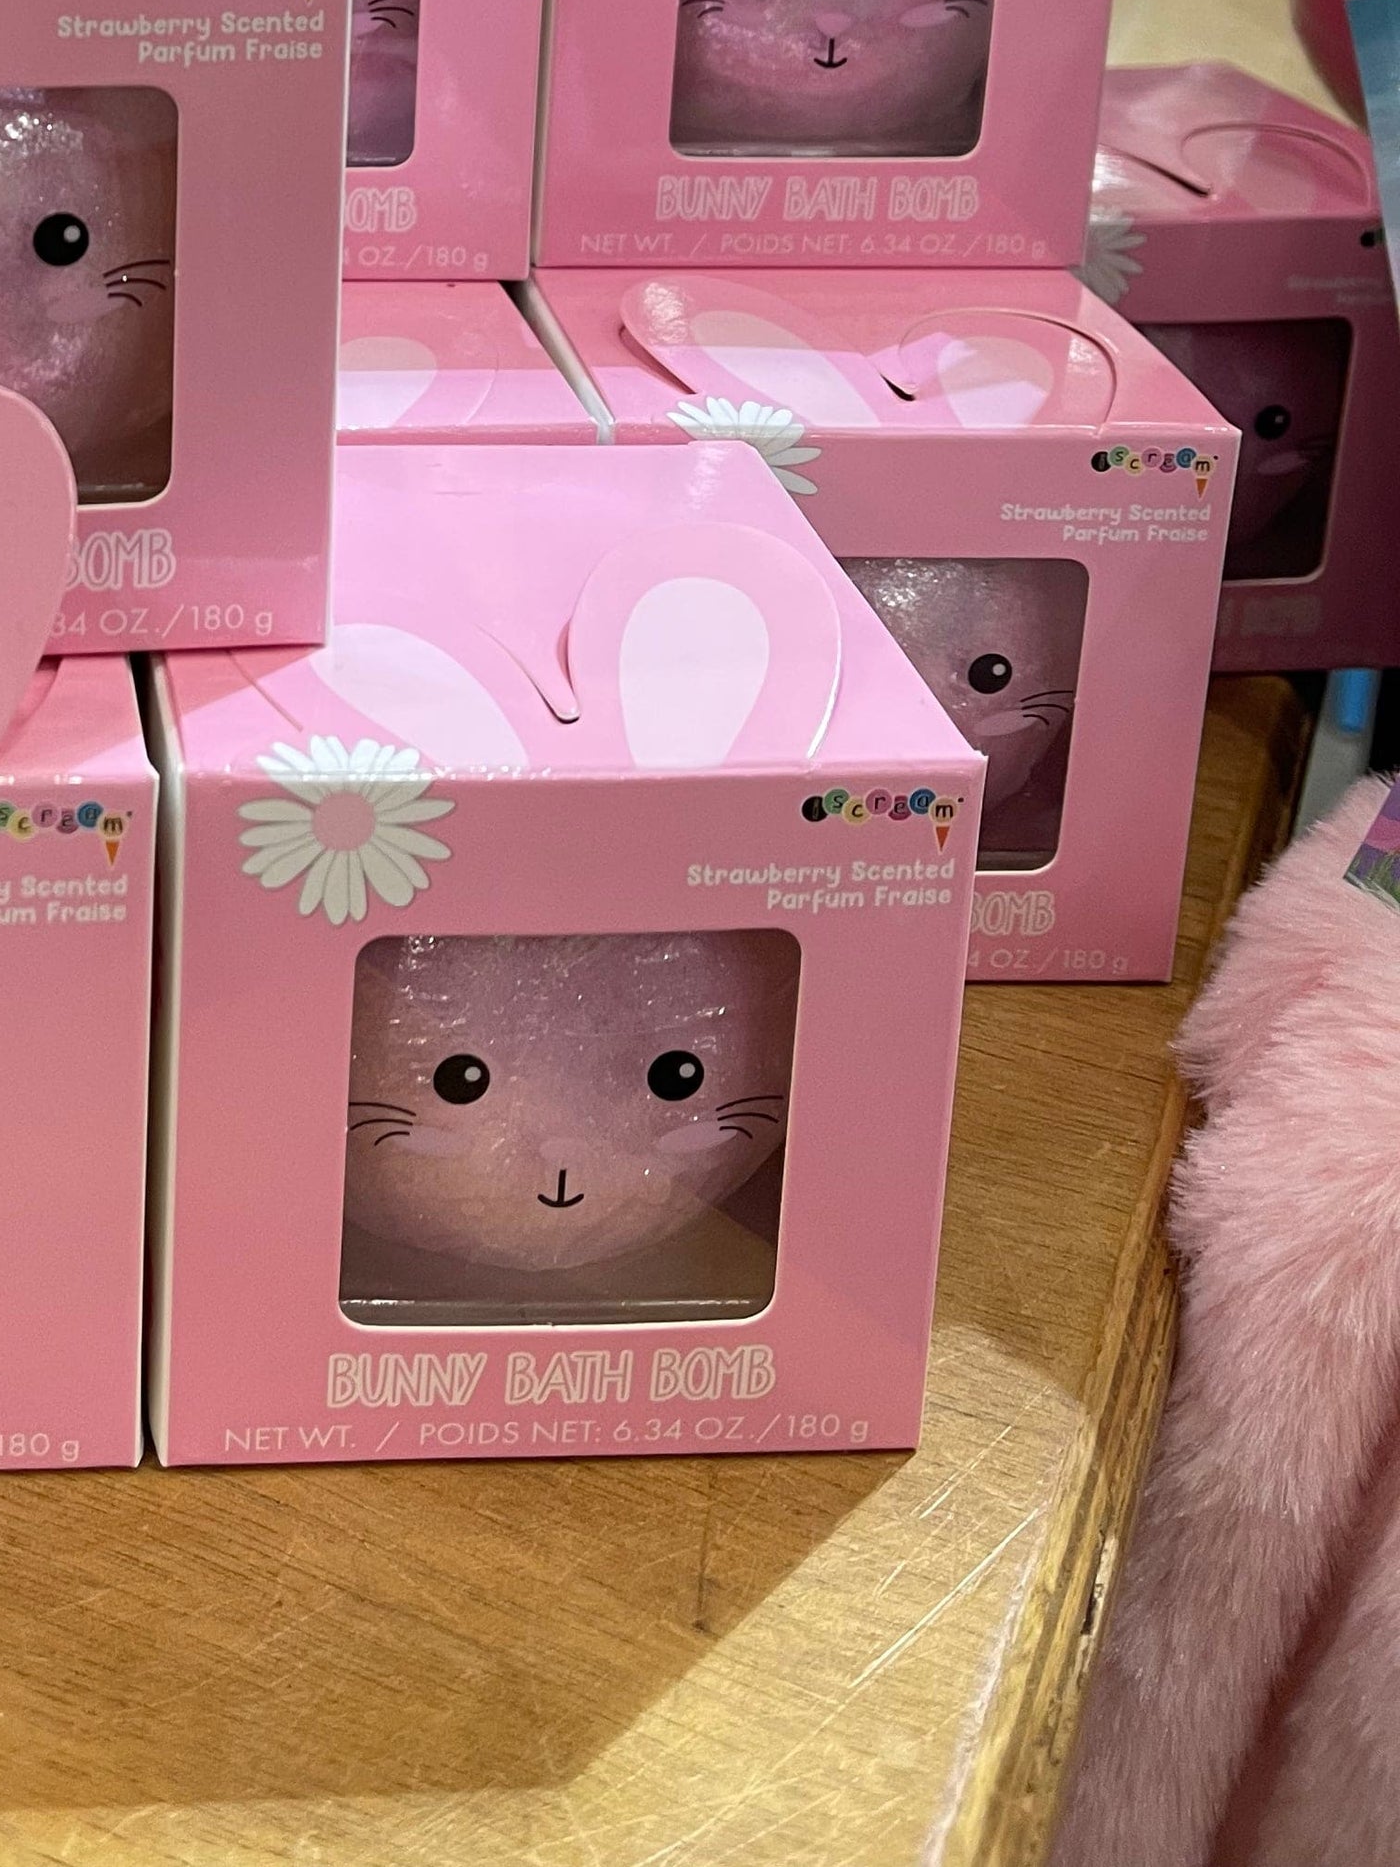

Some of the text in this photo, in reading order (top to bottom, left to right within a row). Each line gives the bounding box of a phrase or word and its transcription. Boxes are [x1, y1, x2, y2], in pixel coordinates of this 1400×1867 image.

[57, 10, 324, 41] Strawberry Scented
[138, 39, 323, 68] Parfum Fraise
[343, 187, 417, 232] OMB
[656, 175, 980, 221] BUNNY BATH BOMB
[581, 233, 627, 254] NET
[721, 233, 794, 254] POIDS
[1000, 503, 1211, 525] Strawberry Scented
[1063, 525, 1208, 545] Parfum Fraise
[255, 611, 273, 636] g
[21, 874, 128, 900] Scented
[687, 858, 955, 888] Strawberry Scented
[47, 901, 127, 923] Fraise
[767, 886, 952, 915] Parfum Fraise
[327, 1344, 776, 1408] BUNNY BATH BOMB
[224, 1426, 289, 1452] NET
[298, 1424, 357, 1449] WT.
[419, 1420, 519, 1445] POIDS
[612, 1418, 683, 1442] 6.34
[850, 1419, 869, 1444] g
[61, 1438, 80, 1463] g
